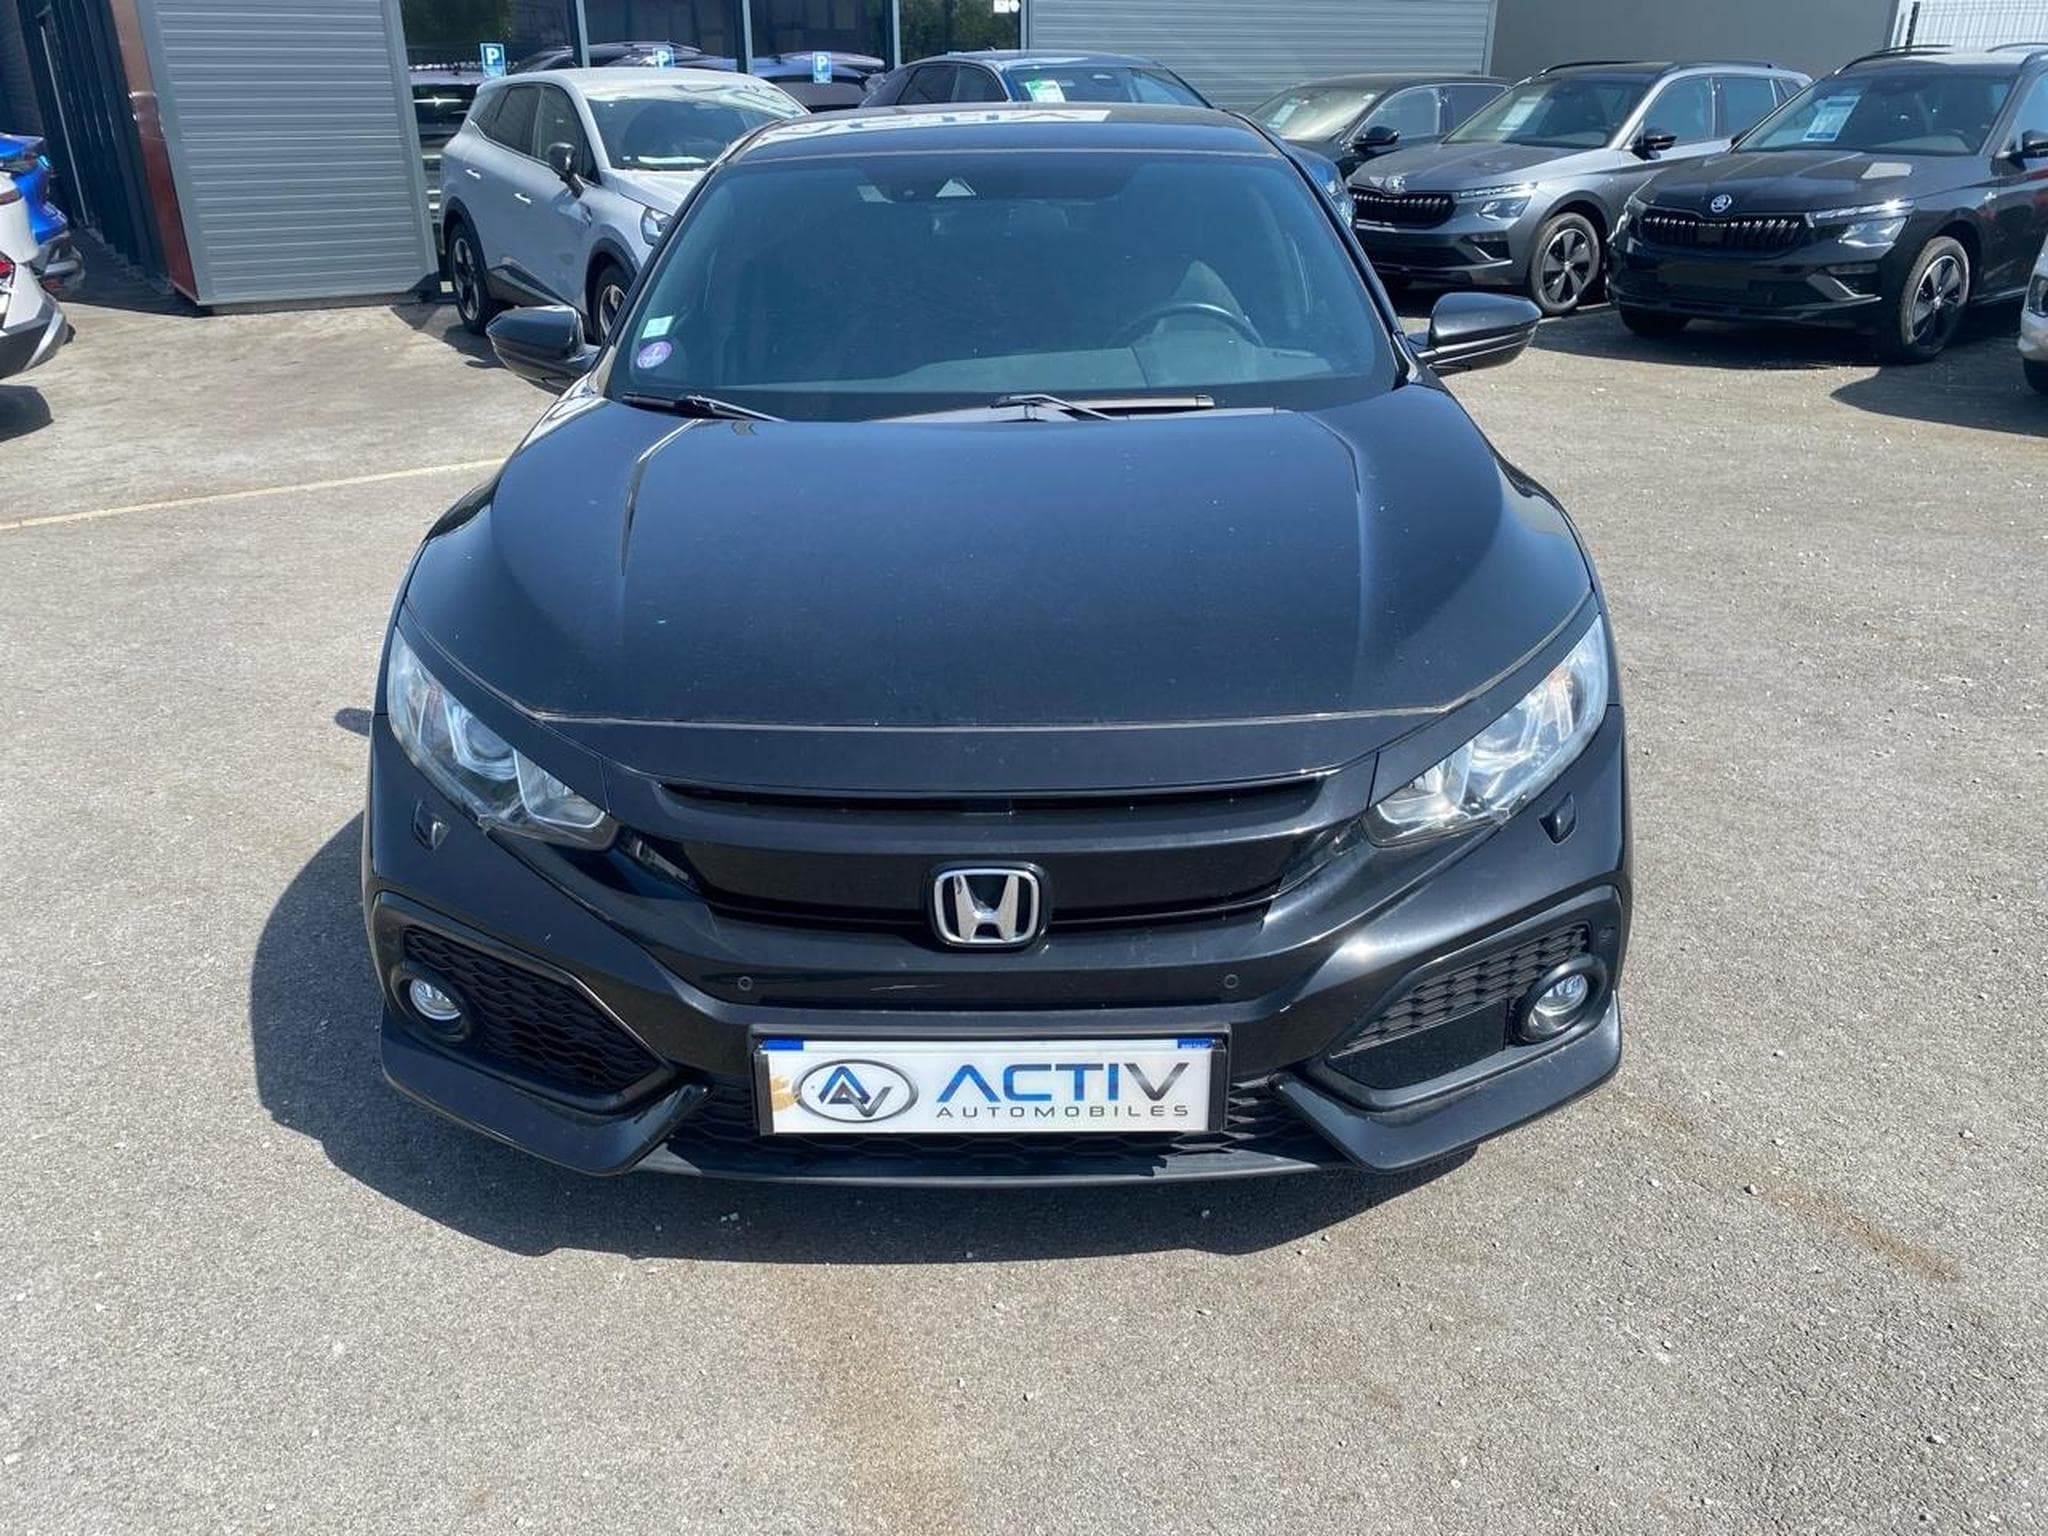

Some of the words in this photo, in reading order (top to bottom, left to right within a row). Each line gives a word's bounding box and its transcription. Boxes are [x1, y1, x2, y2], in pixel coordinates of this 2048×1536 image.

[486, 47, 500, 65] P
[817, 55, 828, 71] P
[936, 1063, 1190, 1102] ACTIV
[936, 1105, 1189, 1118] AUTOMOBILES
